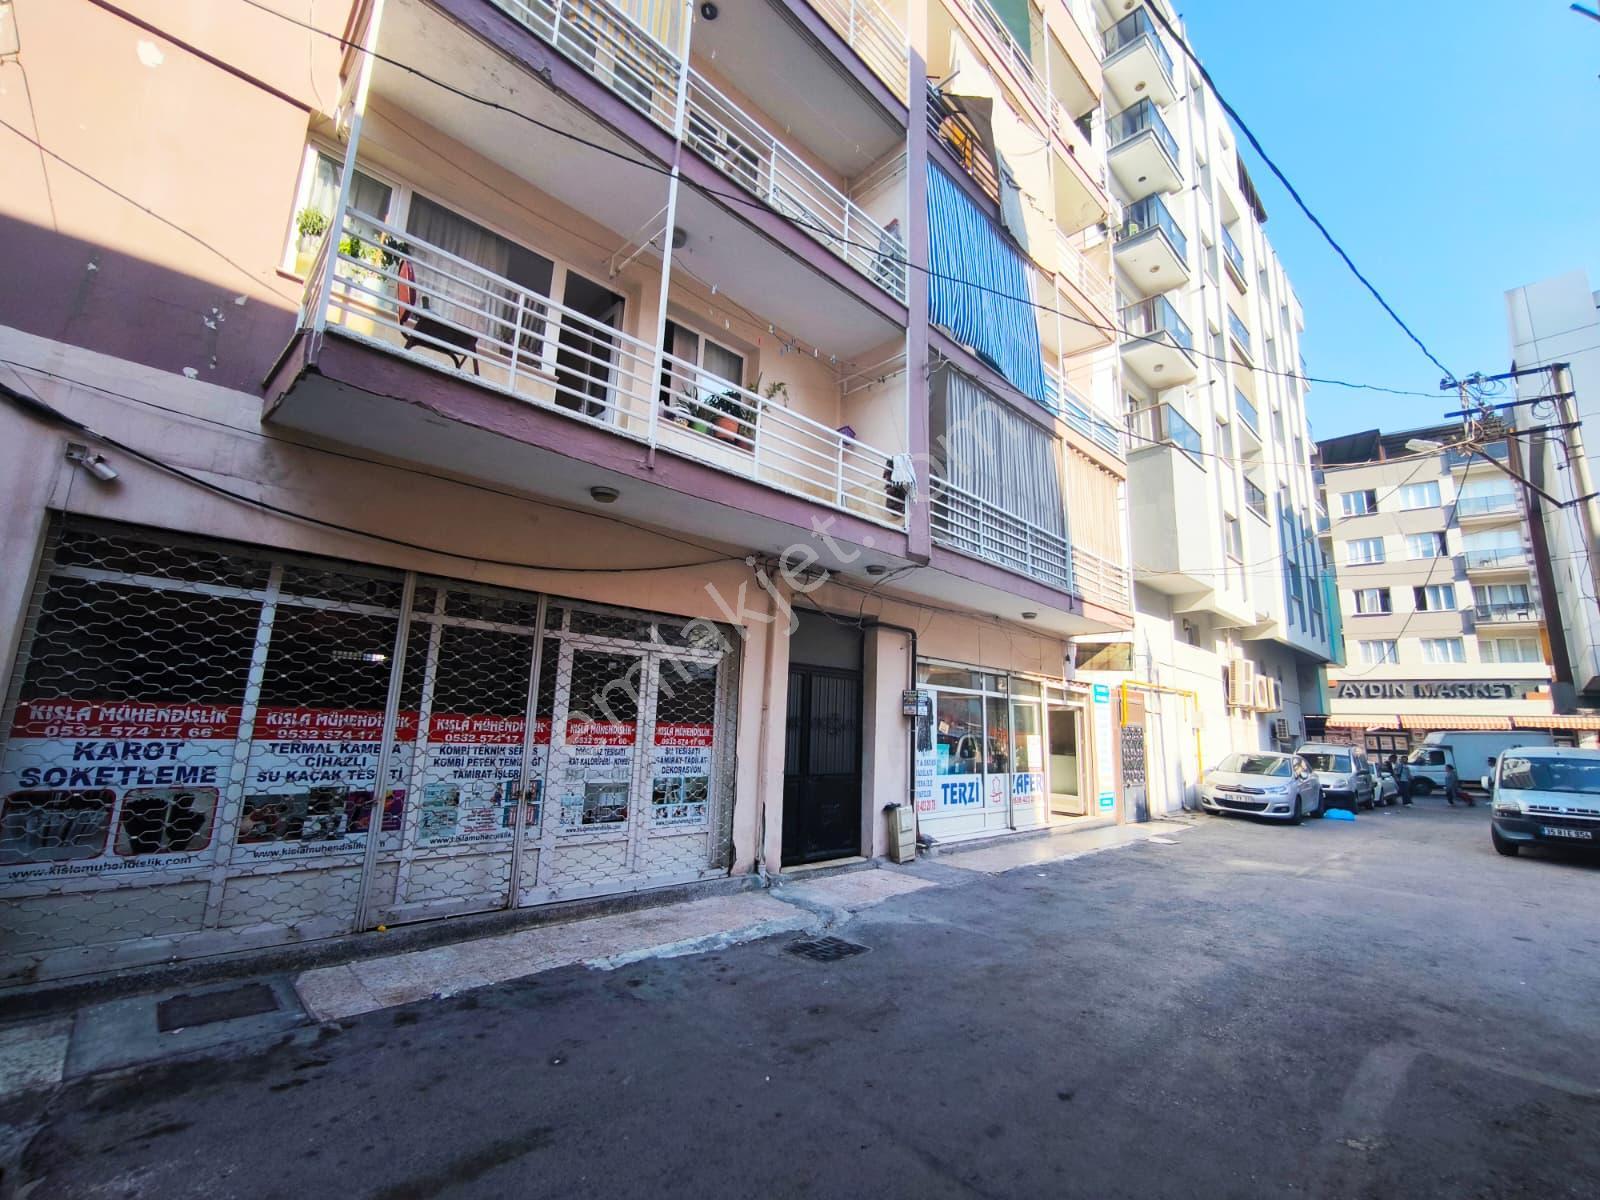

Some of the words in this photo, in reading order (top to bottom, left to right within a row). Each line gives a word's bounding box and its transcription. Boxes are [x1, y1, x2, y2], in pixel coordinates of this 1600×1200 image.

[1339, 682, 1405, 698] AYDIN
[1414, 682, 1517, 698] MARKET
[44, 725, 100, 738] 0532
[110, 726, 149, 738] 574
[188, 727, 213, 738] 66
[445, 734, 475, 743] 0532
[479, 734, 502, 743] 574
[505, 735, 519, 743] 17
[72, 741, 185, 761] KAROT
[268, 742, 333, 754] TERMAL
[339, 743, 402, 754] KAMEA
[439, 744, 470, 755] KOMBİ
[473, 744, 506, 755] TEKNİK
[508, 745, 538, 756] SERS
[305, 754, 367, 767] CİHAZLI
[433, 756, 465, 767] KOMBİ
[466, 758, 496, 767] PETEK
[18, 766, 217, 788] SOKETLEME
[256, 771, 281, 783] SU
[285, 769, 342, 784] KAÇAK
[347, 766, 404, 780] TESTİ
[453, 769, 493, 780] TAMİRAT
[941, 777, 980, 805] TERZİ
